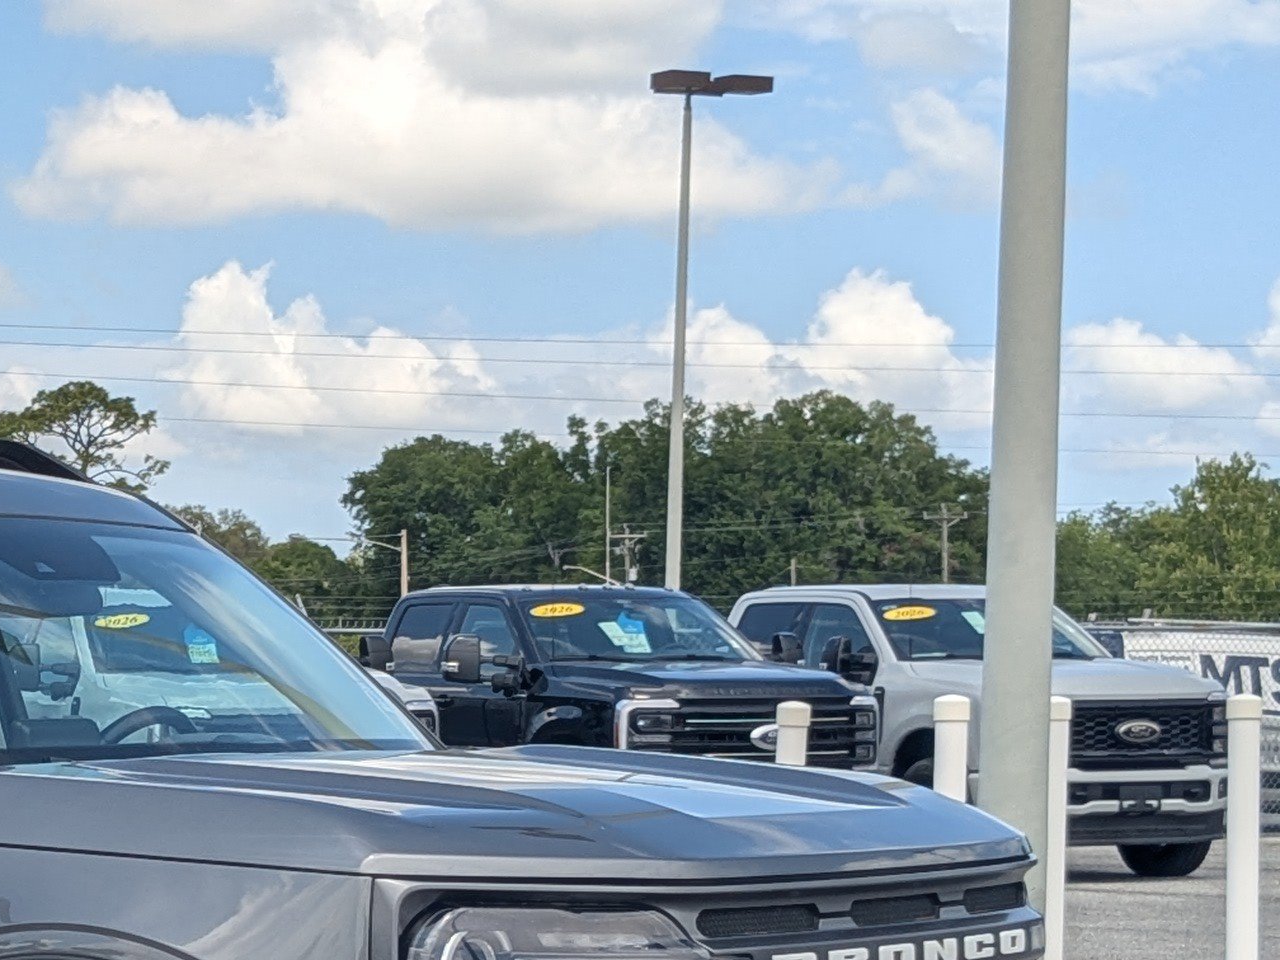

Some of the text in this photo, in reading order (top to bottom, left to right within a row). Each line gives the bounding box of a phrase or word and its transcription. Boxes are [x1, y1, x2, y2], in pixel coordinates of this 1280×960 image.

[542, 605, 574, 616] 2026
[894, 608, 925, 619] 2026
[104, 616, 139, 626] 2026
